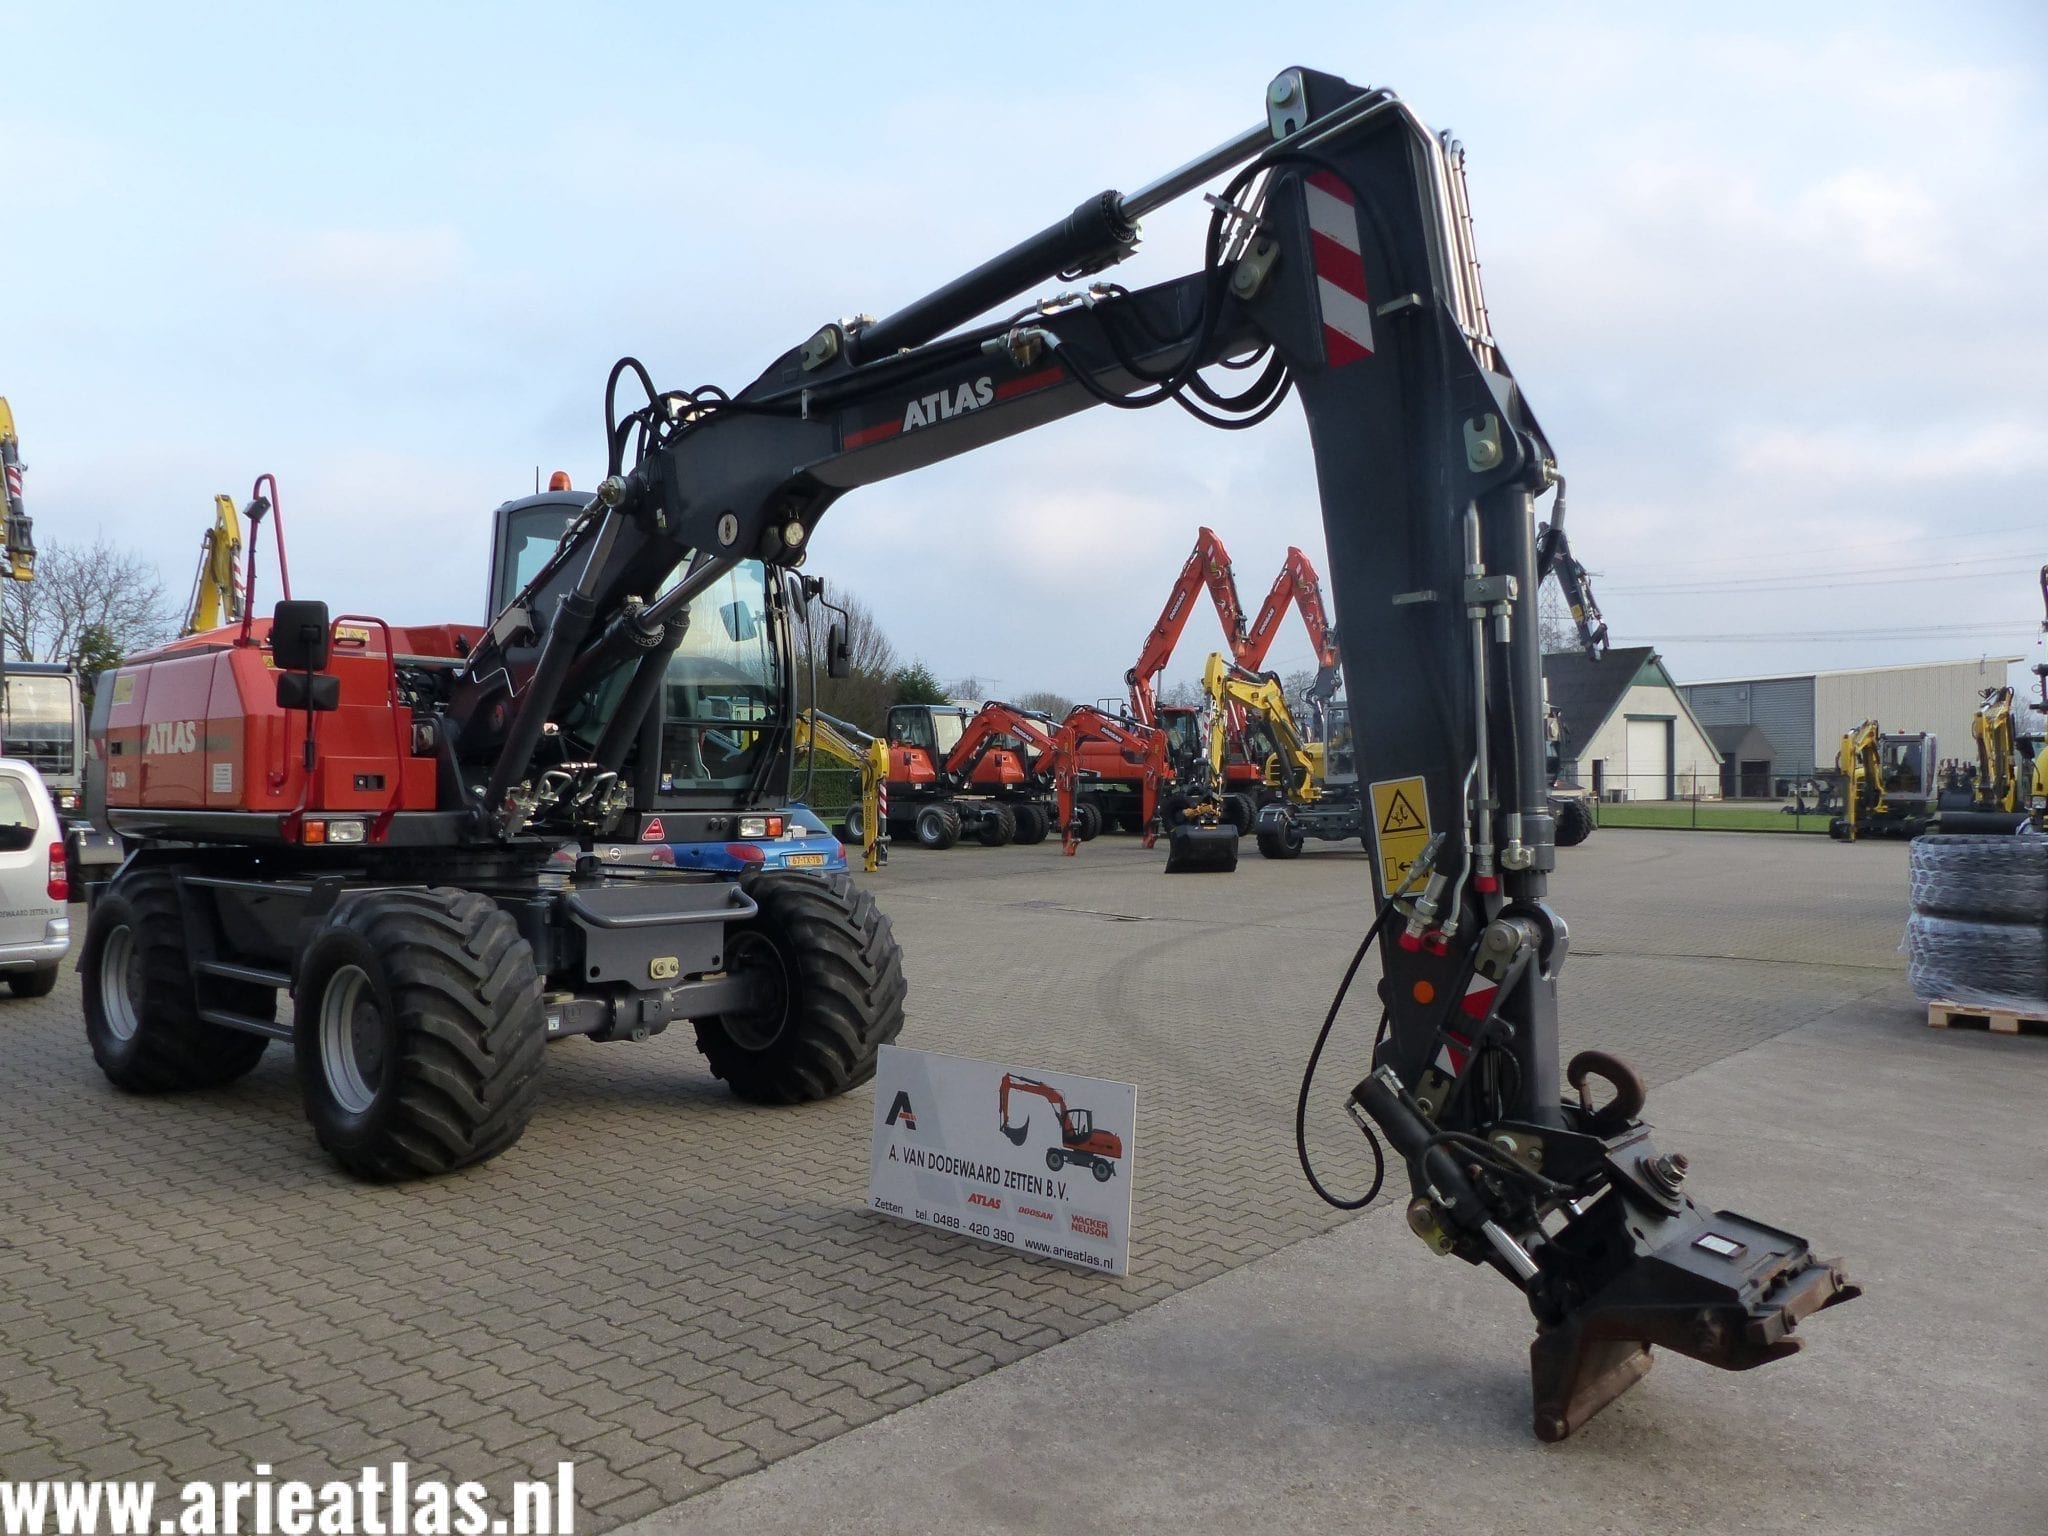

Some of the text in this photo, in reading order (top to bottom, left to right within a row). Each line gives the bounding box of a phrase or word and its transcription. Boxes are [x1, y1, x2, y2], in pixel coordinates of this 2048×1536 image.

[902, 376, 994, 432] ATLAS
[146, 720, 197, 755] ATLAS
[888, 1144, 1069, 1202] A. VAN DODEWAARD ZETTEN B.V.
[967, 1192, 1001, 1211] ATLAS
[1018, 1206, 1054, 1221] DOOSAN
[874, 1197, 904, 1215] Zetten
[915, 1208, 931, 1222] tel.
[933, 1212, 960, 1229] 0488
[969, 1221, 990, 1237] 420
[993, 1227, 1015, 1244] 390
[1024, 1238, 1114, 1270] www.arieatlas.nl
[1071, 1214, 1108, 1230] WACKER
[1071, 1223, 1109, 1239] NEUSON
